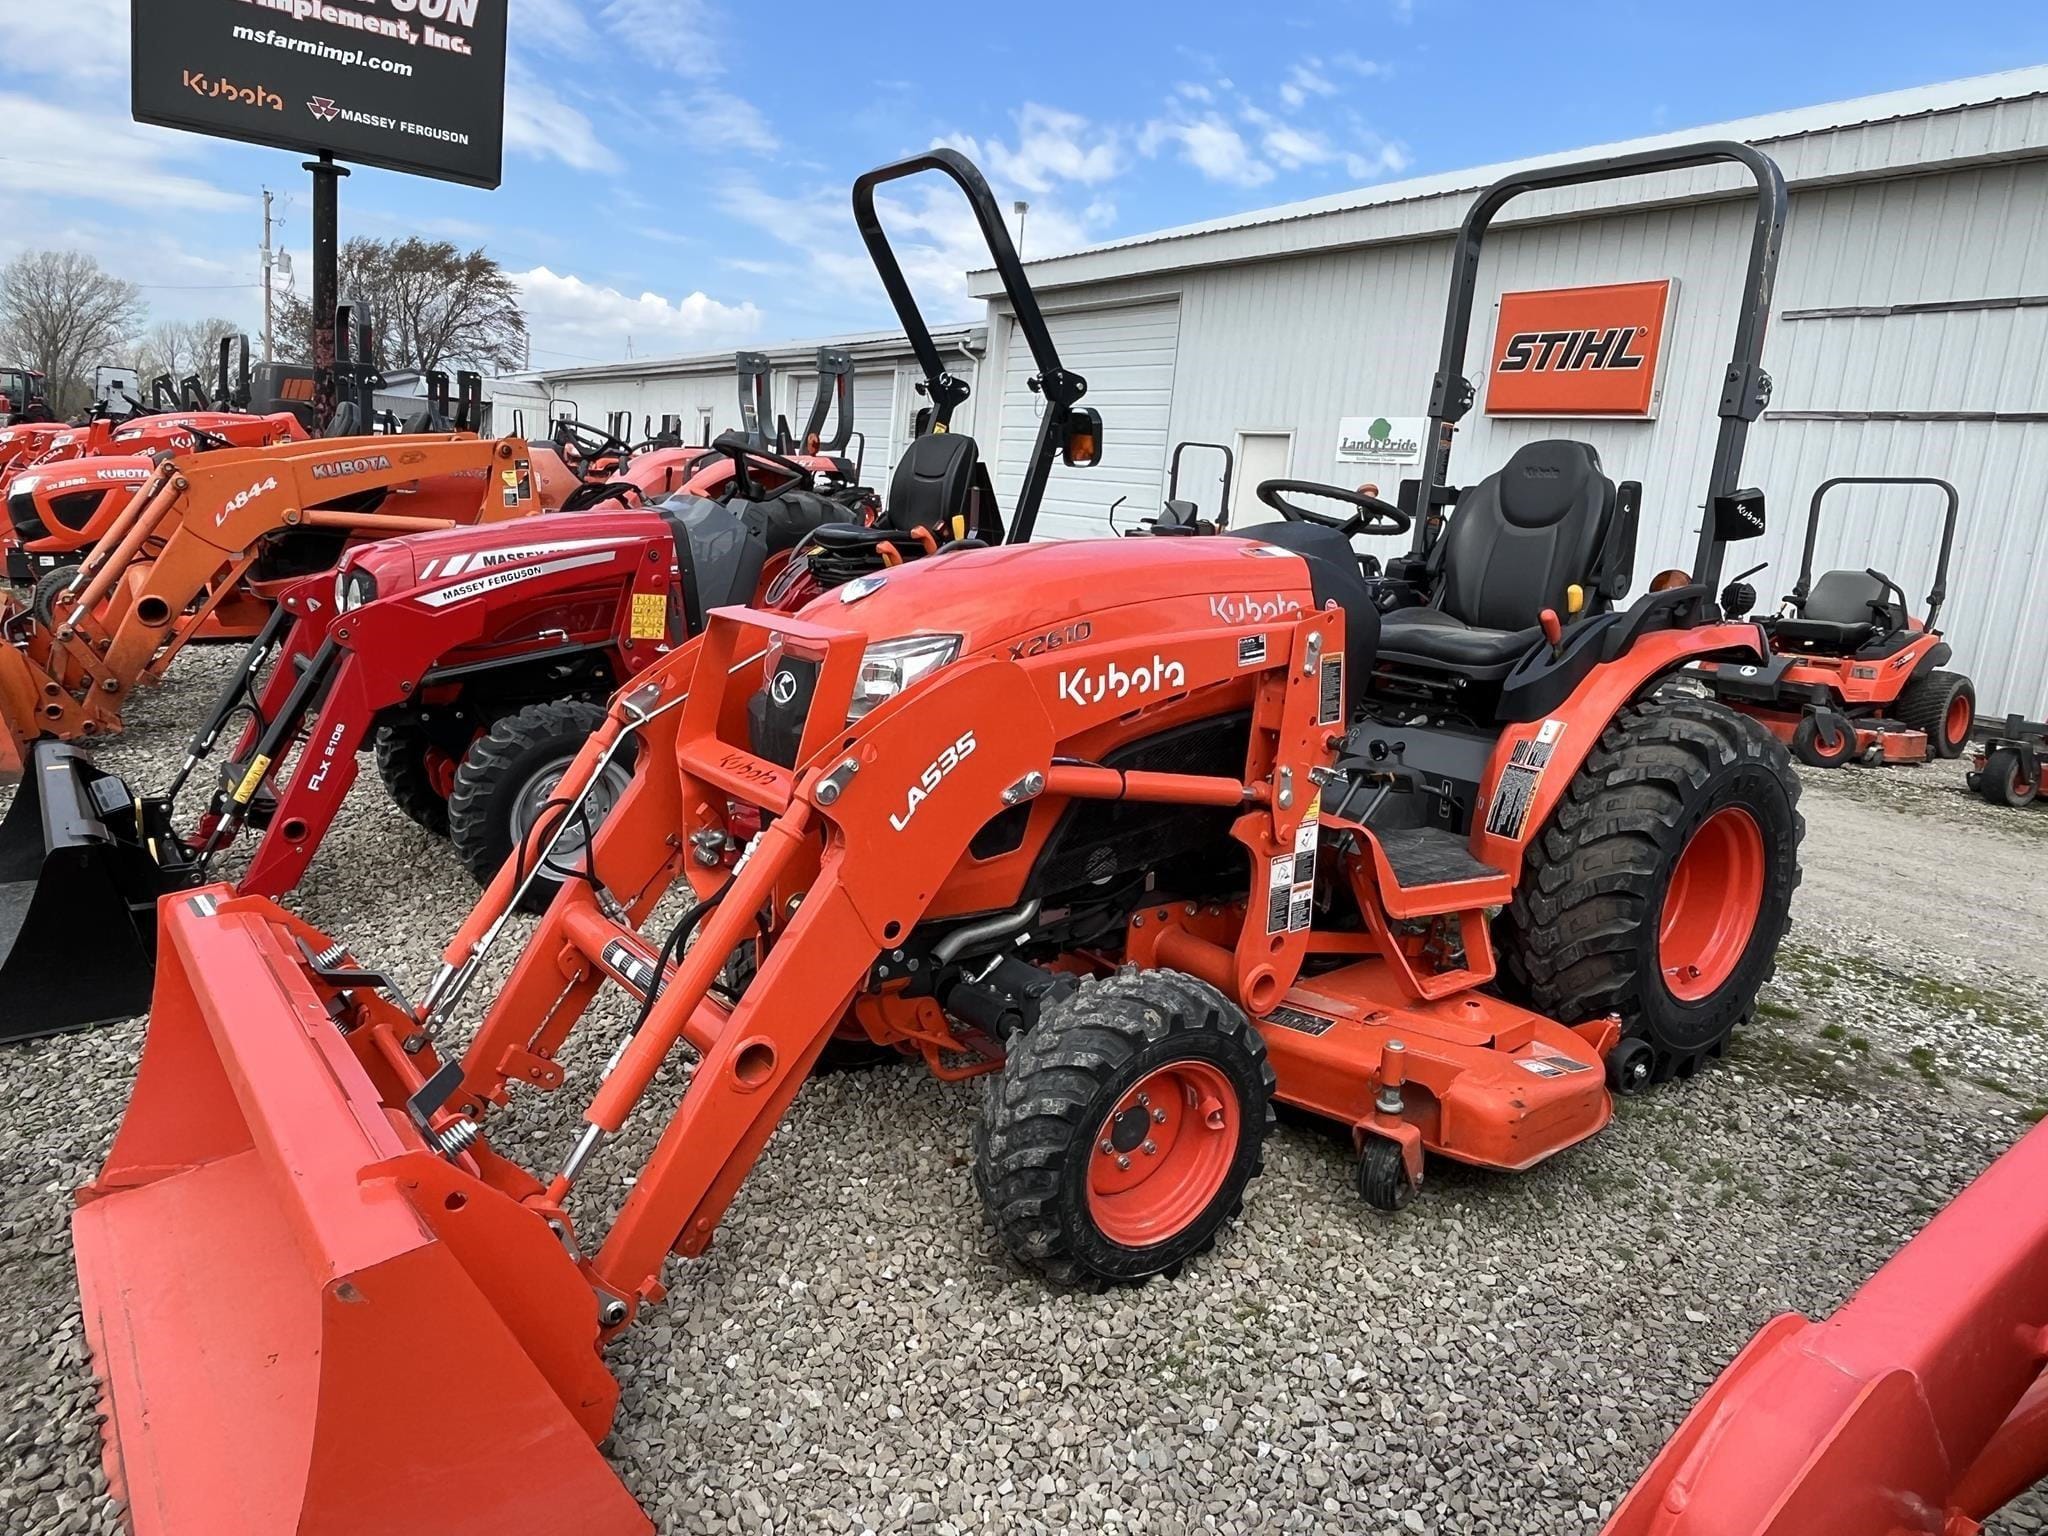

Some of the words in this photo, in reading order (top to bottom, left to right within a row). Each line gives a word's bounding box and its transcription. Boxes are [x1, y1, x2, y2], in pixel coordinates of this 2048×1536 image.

[233, 25, 413, 77] msfarmimpl.com
[423, 25, 472, 56] Inc.
[182, 70, 283, 111] Kubota
[341, 109, 396, 130] MASSEY
[400, 120, 469, 145] FERGUSON
[1497, 327, 1645, 373] STIHL
[1341, 437, 1374, 450] Land
[1382, 438, 1417, 451] Pride
[96, 468, 152, 480] KUBOTA
[311, 455, 392, 480] KUBOTA
[215, 476, 278, 528] LA844
[1736, 503, 1764, 529] Kubota
[442, 580, 486, 600] MASSEY
[488, 566, 542, 587] FERGUSON
[1058, 654, 1185, 706] Kubota
[307, 759, 332, 792] FLX
[720, 753, 777, 785] Kubota
[888, 729, 977, 832] LA535
